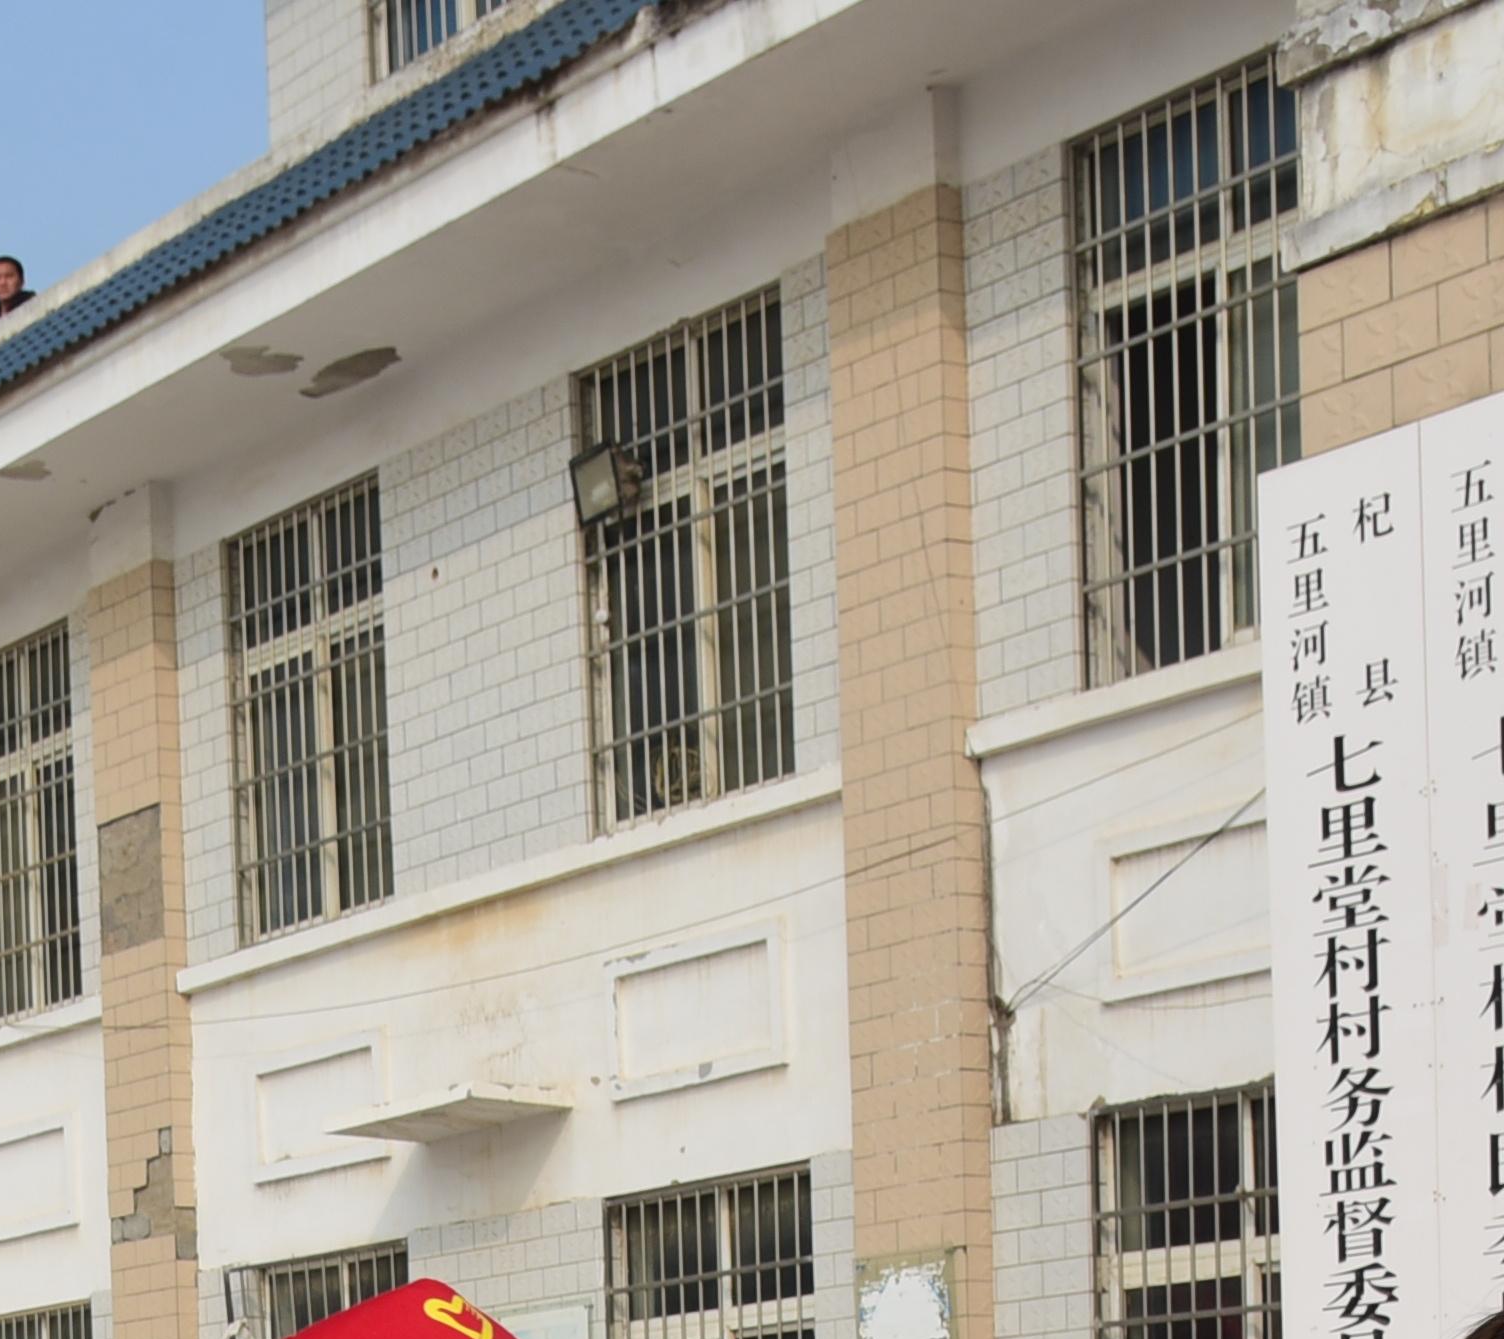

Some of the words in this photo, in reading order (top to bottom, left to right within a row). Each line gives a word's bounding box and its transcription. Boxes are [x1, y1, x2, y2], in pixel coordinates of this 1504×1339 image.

[1285, 513, 1333, 725] 五里河镇
[1450, 460, 1499, 681] 五里河镇
